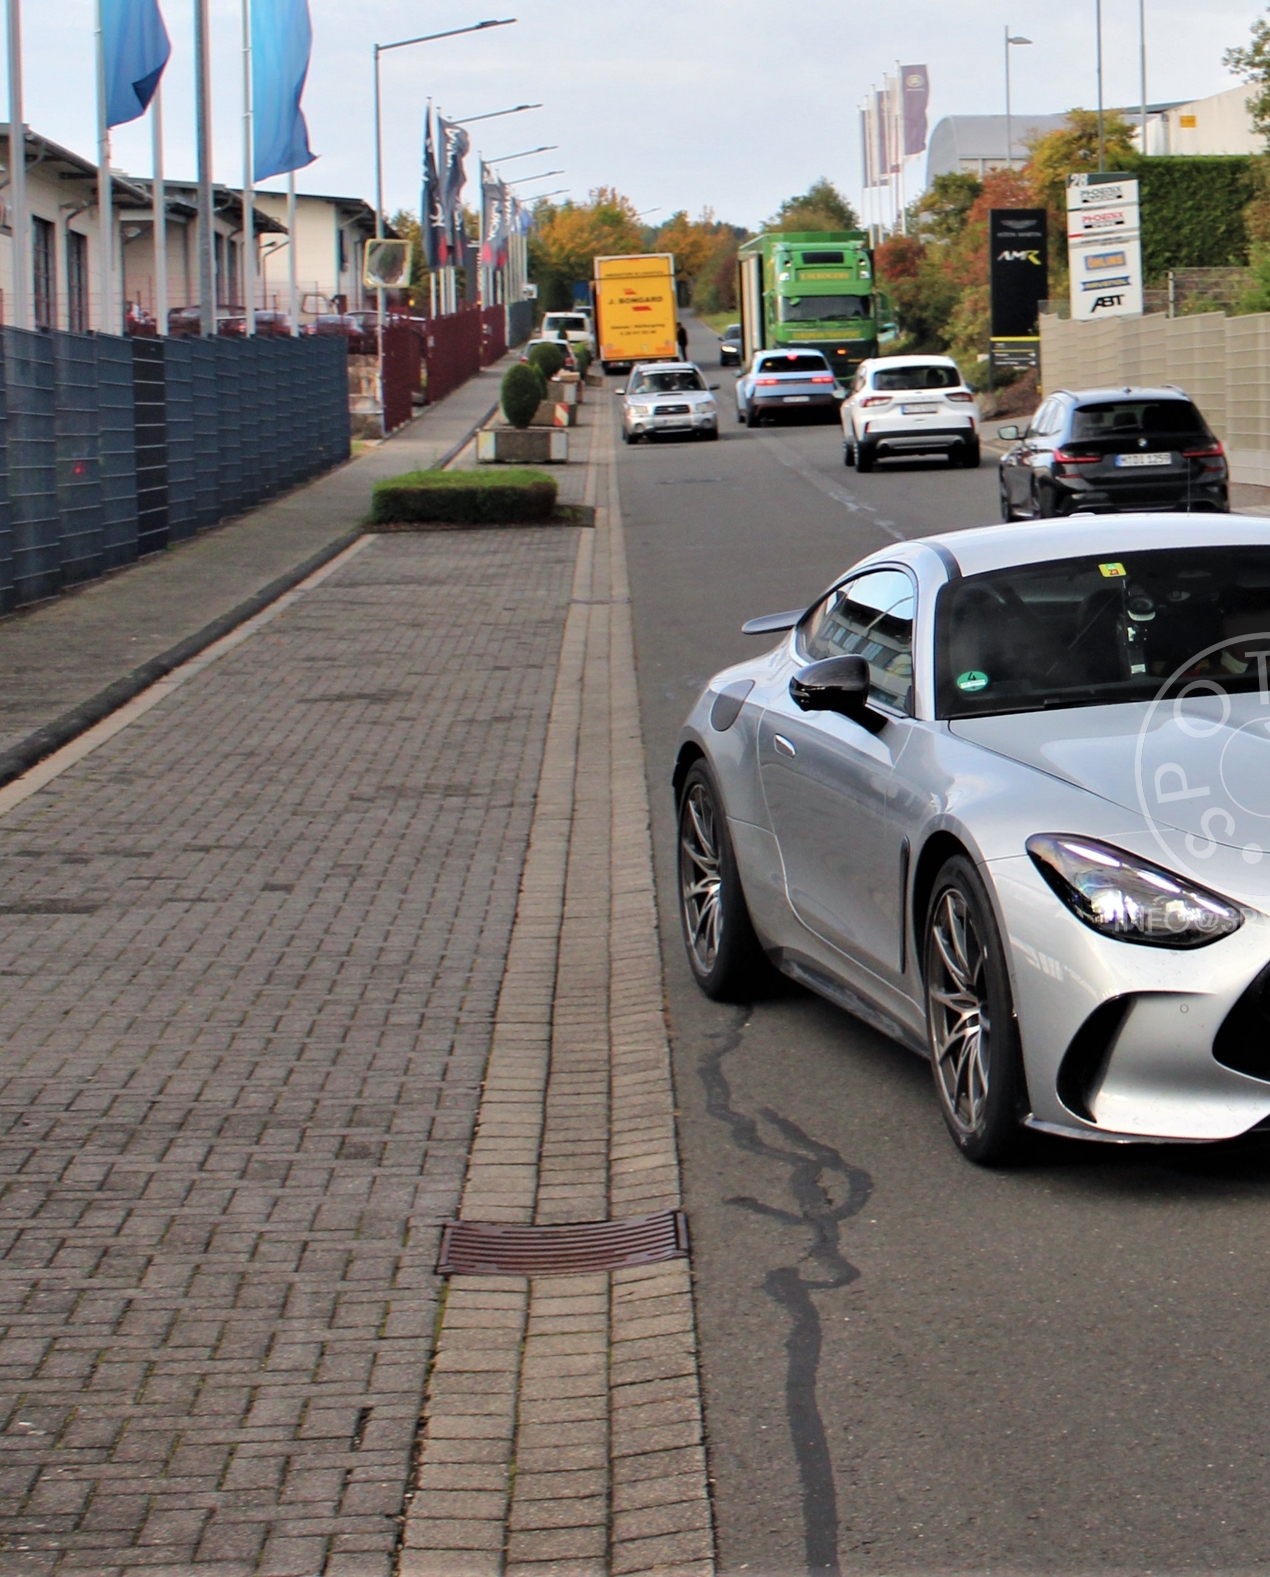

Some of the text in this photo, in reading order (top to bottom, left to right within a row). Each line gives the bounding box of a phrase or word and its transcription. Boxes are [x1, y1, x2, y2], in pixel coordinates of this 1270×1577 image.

[1070, 173, 1088, 188] 28
[997, 250, 1042, 265] AMR
[618, 296, 663, 304] BONGARD
[1090, 294, 1125, 313] ABT
